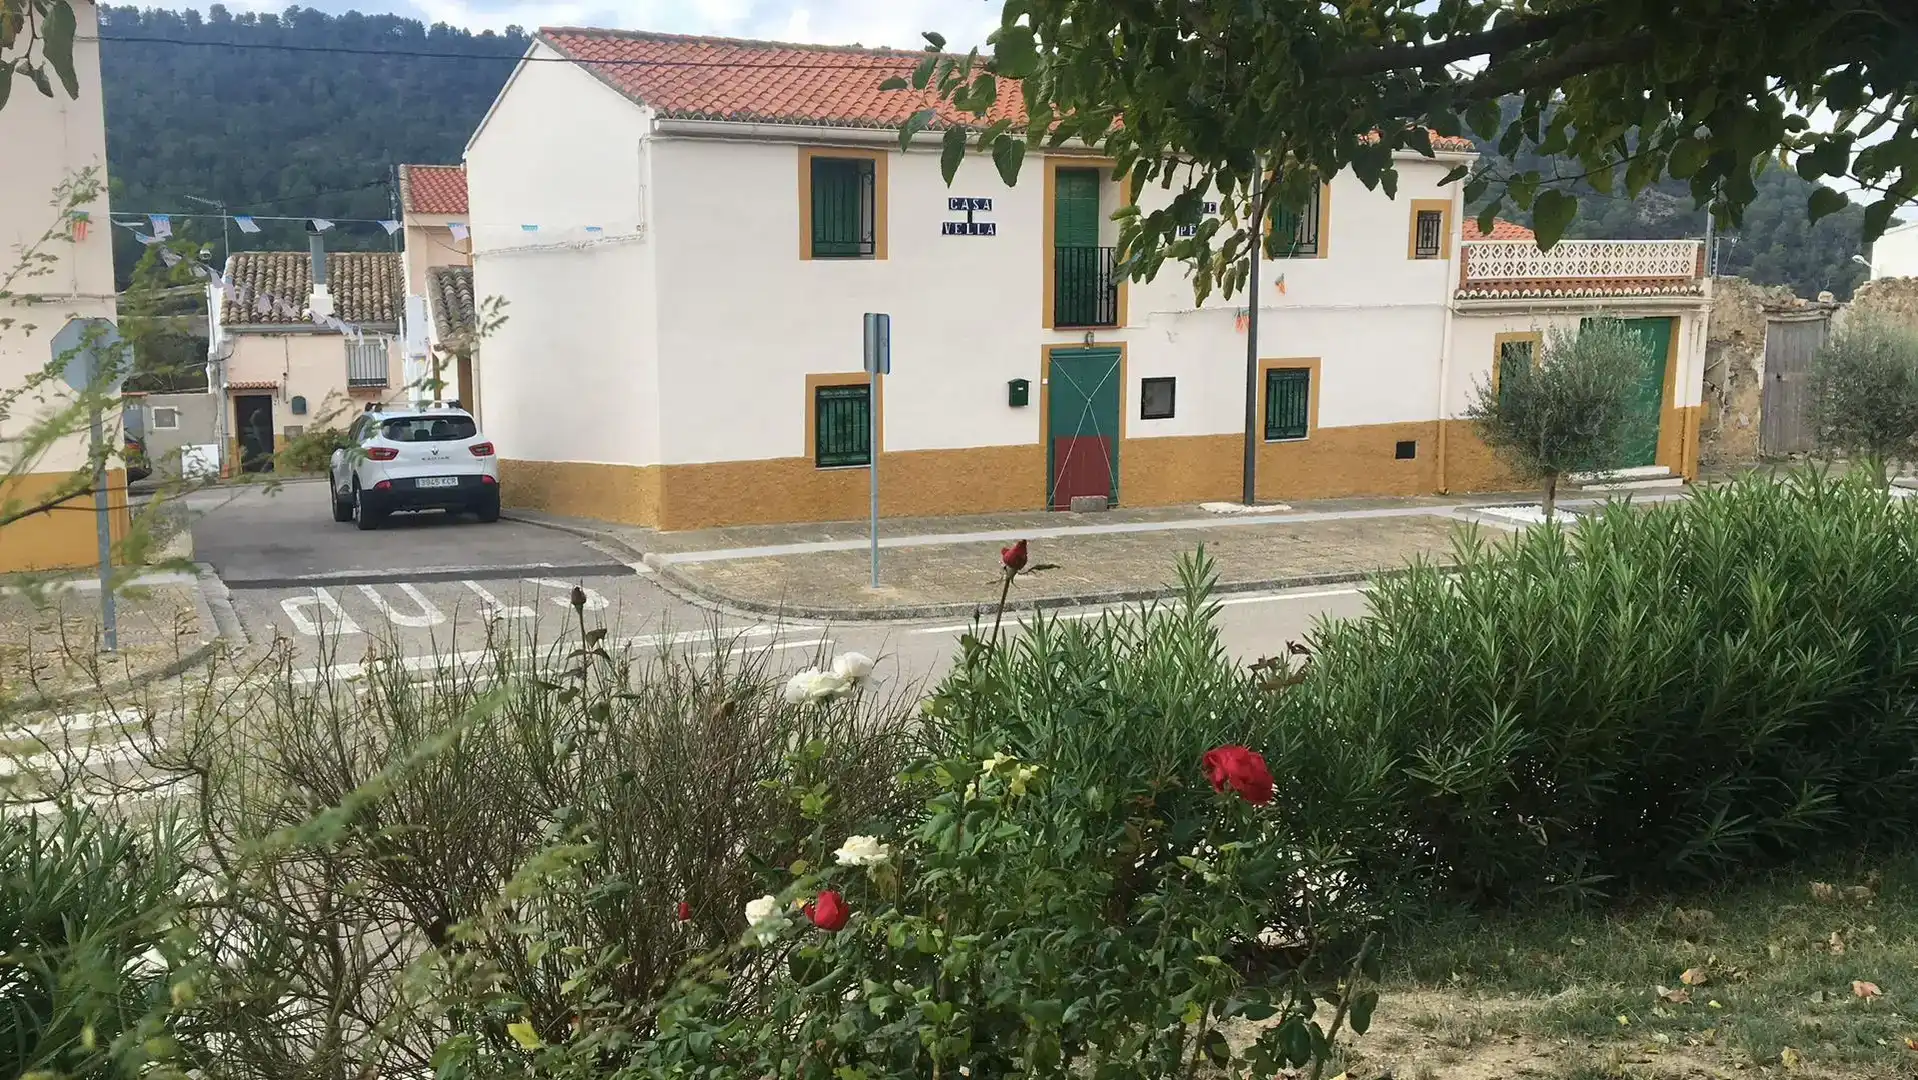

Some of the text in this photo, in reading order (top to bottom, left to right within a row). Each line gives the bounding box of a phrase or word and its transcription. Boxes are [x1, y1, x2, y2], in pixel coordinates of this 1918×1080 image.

[950, 198, 990, 210] CASA
[944, 222, 994, 235] VELLA
[280, 577, 609, 636] STOP
